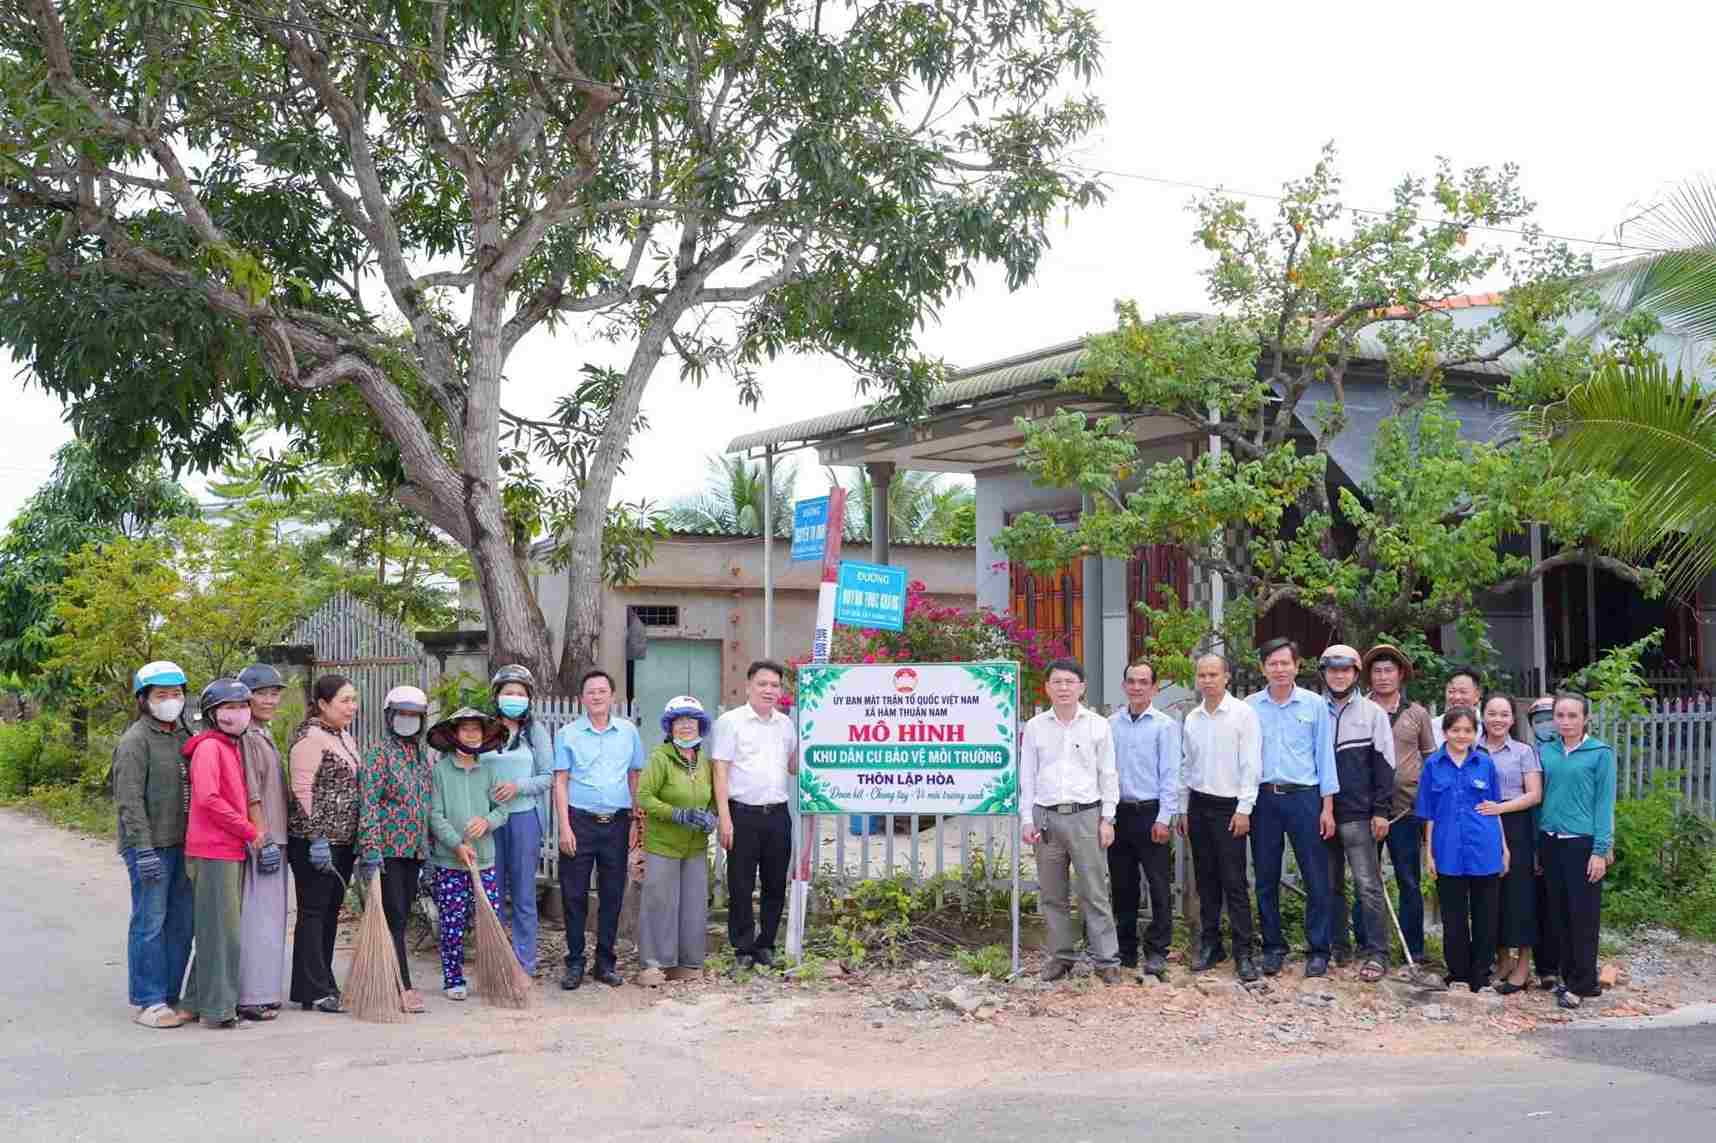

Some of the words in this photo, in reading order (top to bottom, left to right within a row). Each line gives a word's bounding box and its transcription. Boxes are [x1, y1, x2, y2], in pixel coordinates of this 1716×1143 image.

[846, 696, 862, 704] BAN
[917, 692, 939, 705] QUỐC
[941, 694, 959, 707] VIỆT
[961, 696, 979, 704] NAM
[929, 708, 948, 716] NAM
[848, 720, 890, 742] MÔ
[898, 720, 965, 742] HÌNH
[813, 750, 837, 763] KHU
[839, 747, 864, 763] DÂN
[911, 747, 926, 766] VỆ
[928, 747, 952, 763] MÔI
[953, 747, 1002, 763] TRƯỜNG
[857, 772, 894, 785] THÔN
[897, 772, 923, 787] LẬP
[926, 772, 955, 785] HÒA
